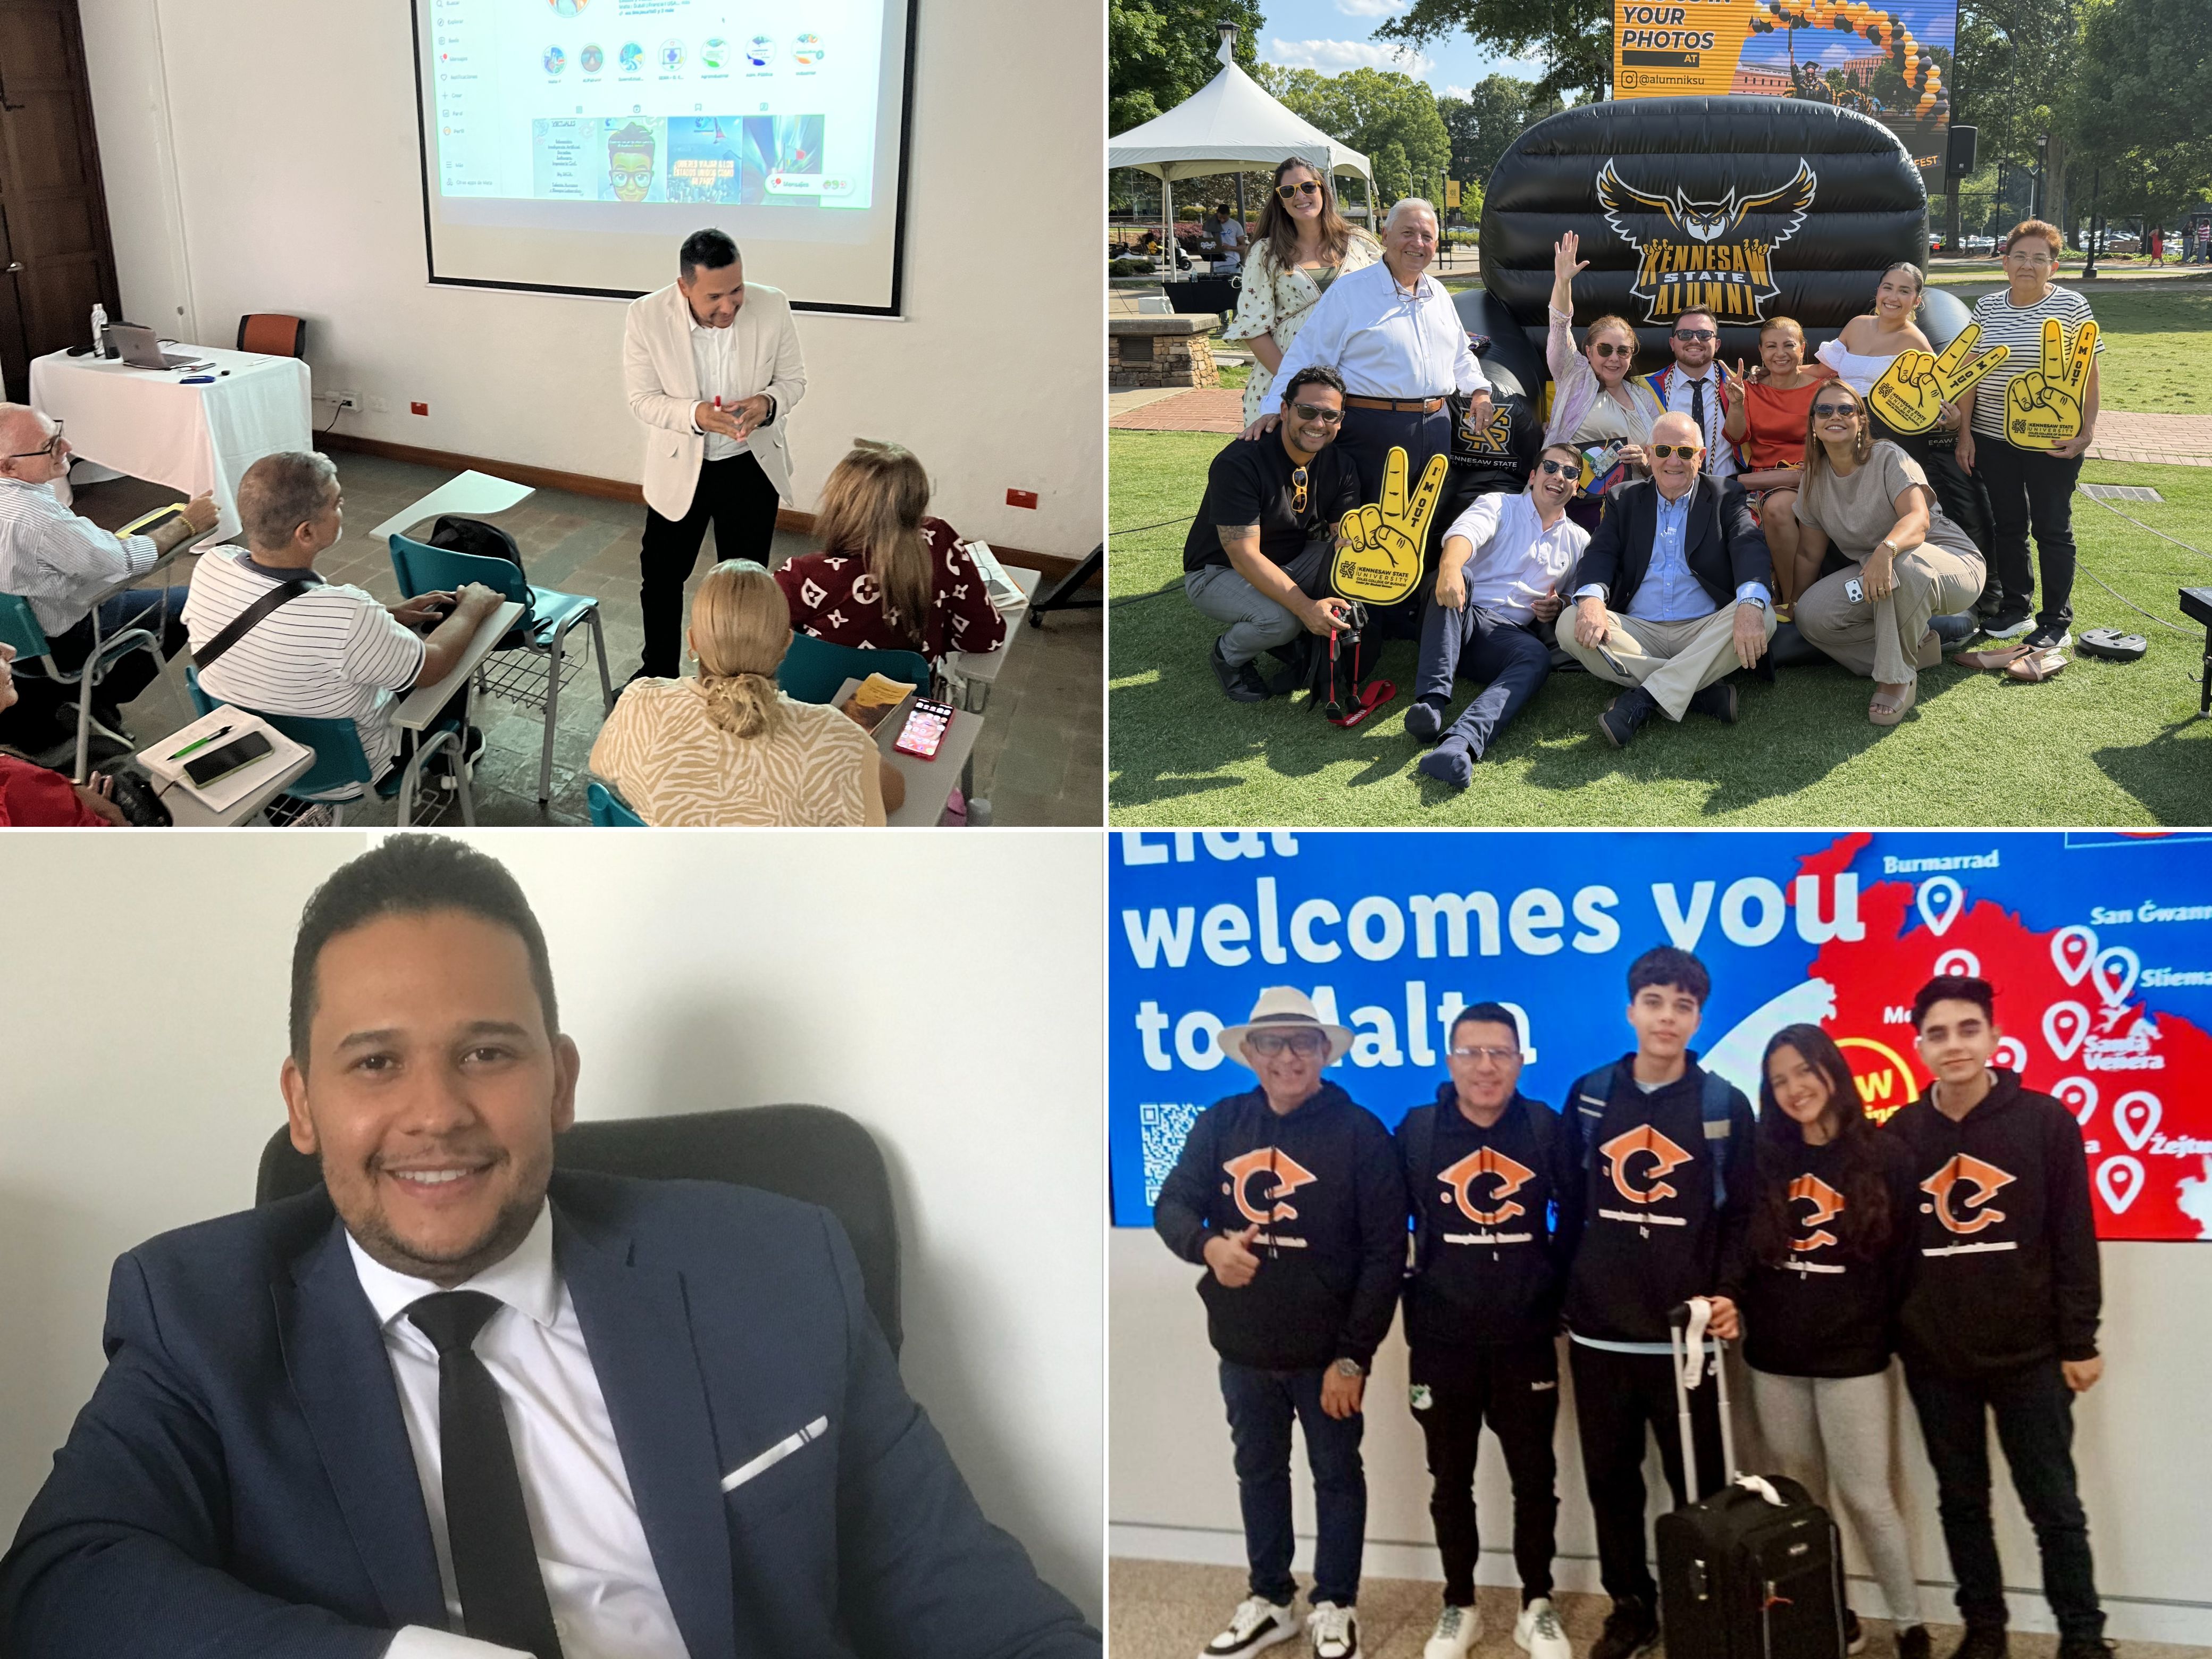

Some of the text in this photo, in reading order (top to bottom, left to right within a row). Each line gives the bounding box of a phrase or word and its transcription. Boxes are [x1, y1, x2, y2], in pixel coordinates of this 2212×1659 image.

[1622, 6, 1686, 26] YOUR
[1621, 29, 1715, 50] PHOTOS
[1684, 54, 1698, 63] AT
[1639, 74, 1705, 86] @alumniksu
[1640, 245, 1770, 287] KENNESAW
[1664, 272, 1745, 283] STATE
[1654, 282, 1755, 316] ALUMNI
[1890, 396, 1924, 424] UNIVERSITY
[1893, 392, 1915, 411] KENNESAW
[1914, 410, 1927, 421] STATE
[1449, 455, 1492, 465] ENNESAW
[1410, 498, 1427, 527] OUT
[1357, 572, 1408, 583] UNIVERSITY
[1359, 567, 1392, 575] KENNESAW
[1346, 709, 1367, 725] anon
[1883, 849, 2000, 874] Burmarrad
[1122, 873, 1866, 969] welcomes you
[2090, 907, 2133, 925] San
[1135, 1000, 1225, 1071] to
